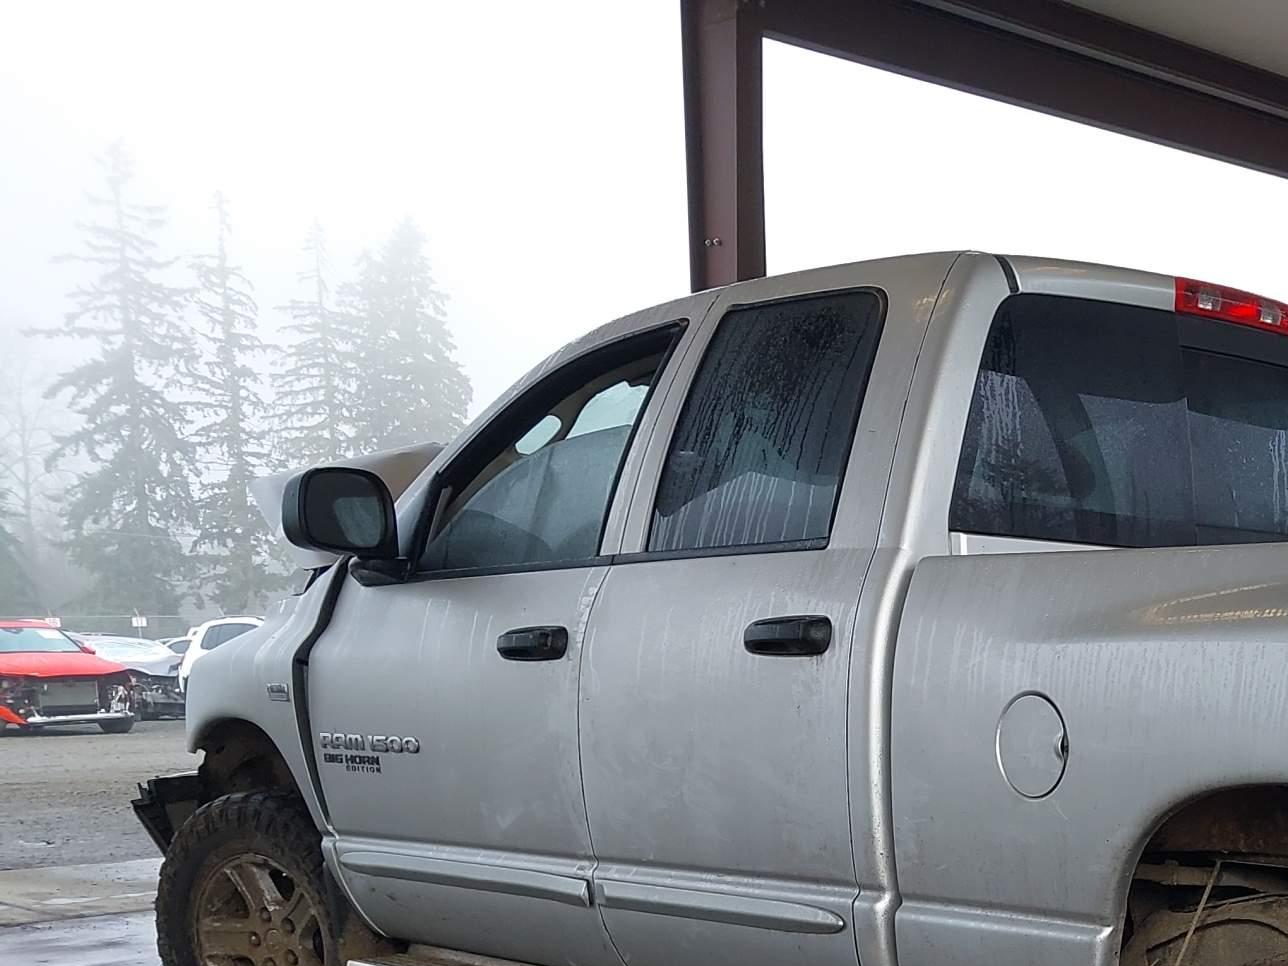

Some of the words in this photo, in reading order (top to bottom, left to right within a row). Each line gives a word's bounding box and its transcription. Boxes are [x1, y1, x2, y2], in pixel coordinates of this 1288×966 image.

[320, 732, 365, 751] RAM
[367, 735, 421, 754] 1500
[323, 753, 344, 764] BIG
[345, 754, 380, 766] HORN
[345, 765, 382, 774] EDITION
